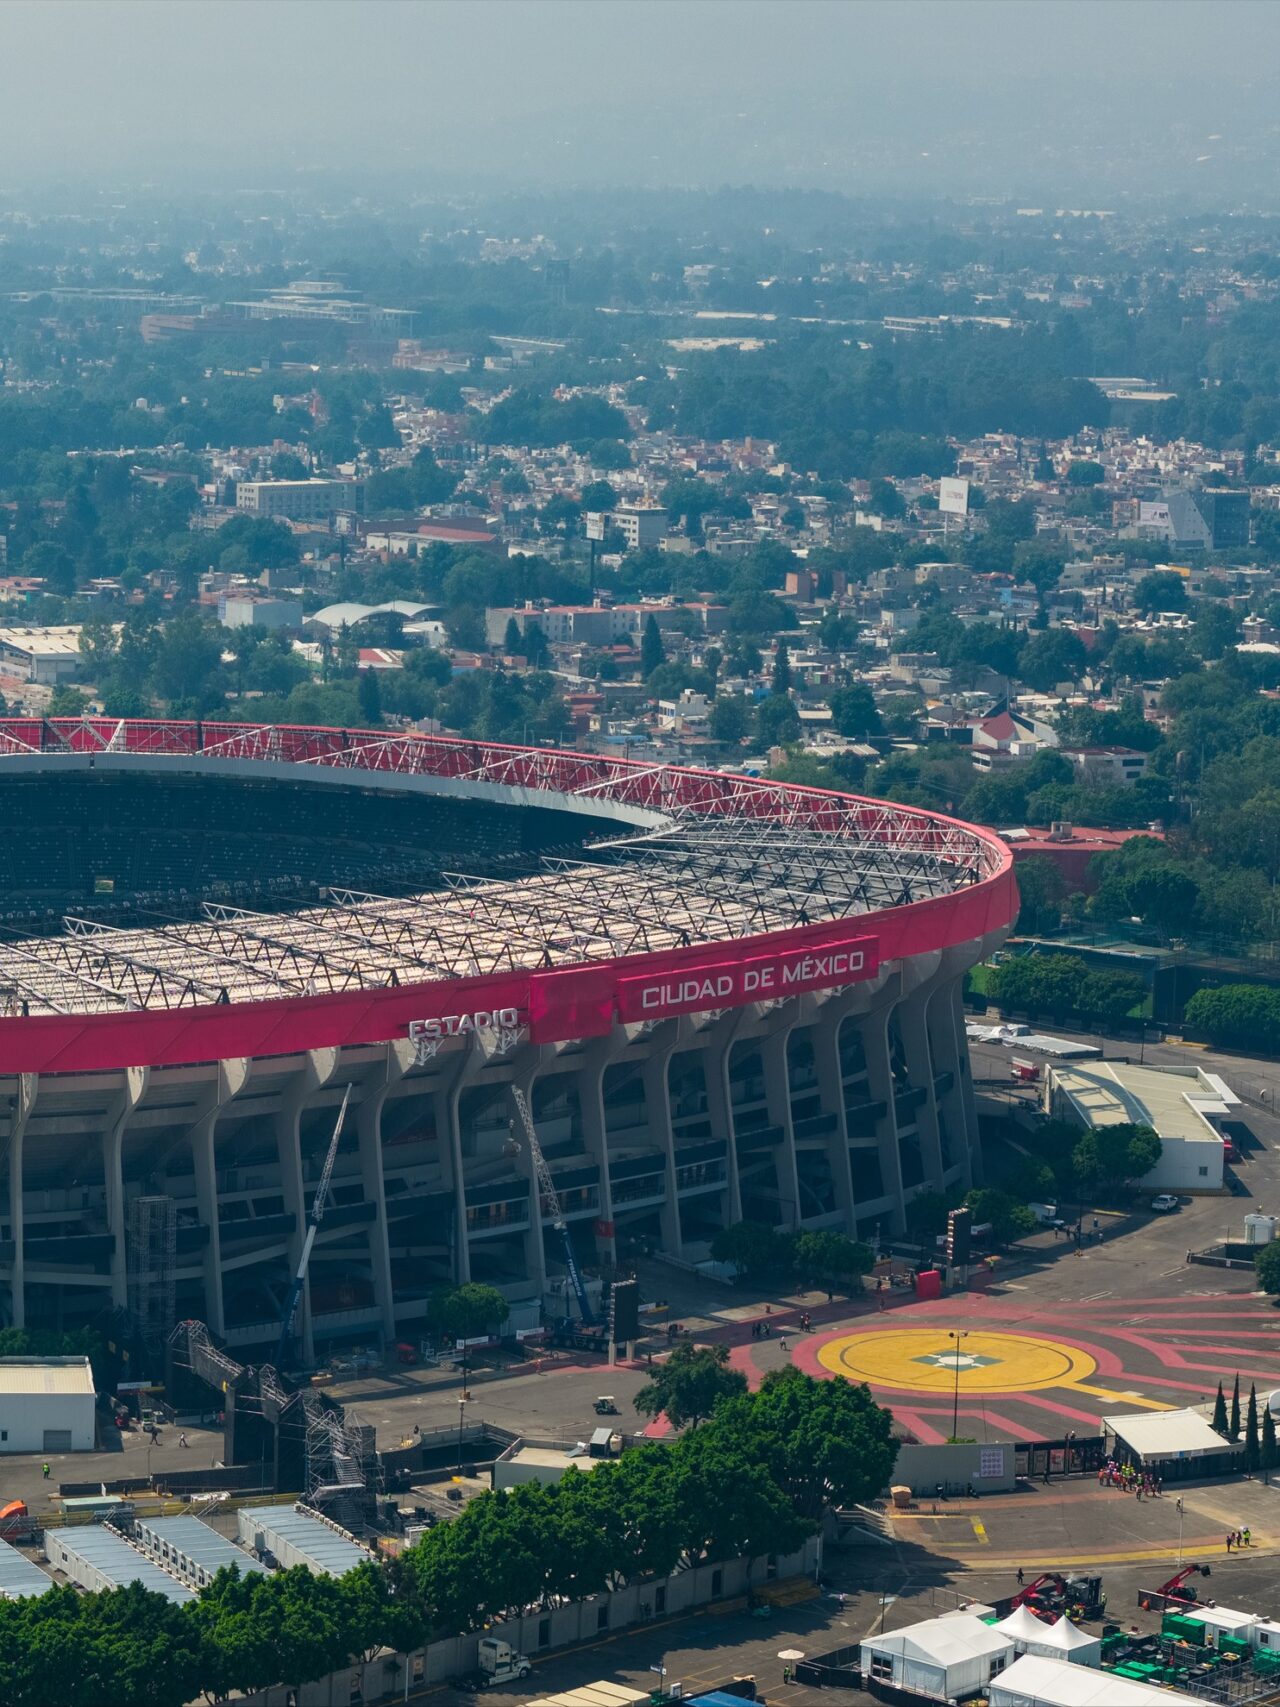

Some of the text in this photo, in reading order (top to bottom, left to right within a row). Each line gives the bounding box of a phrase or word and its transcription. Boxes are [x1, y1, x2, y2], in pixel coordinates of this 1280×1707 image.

[642, 951, 864, 1009] CIUDAD DE MÉXICO
[409, 1007, 518, 1040] ESTADIO
